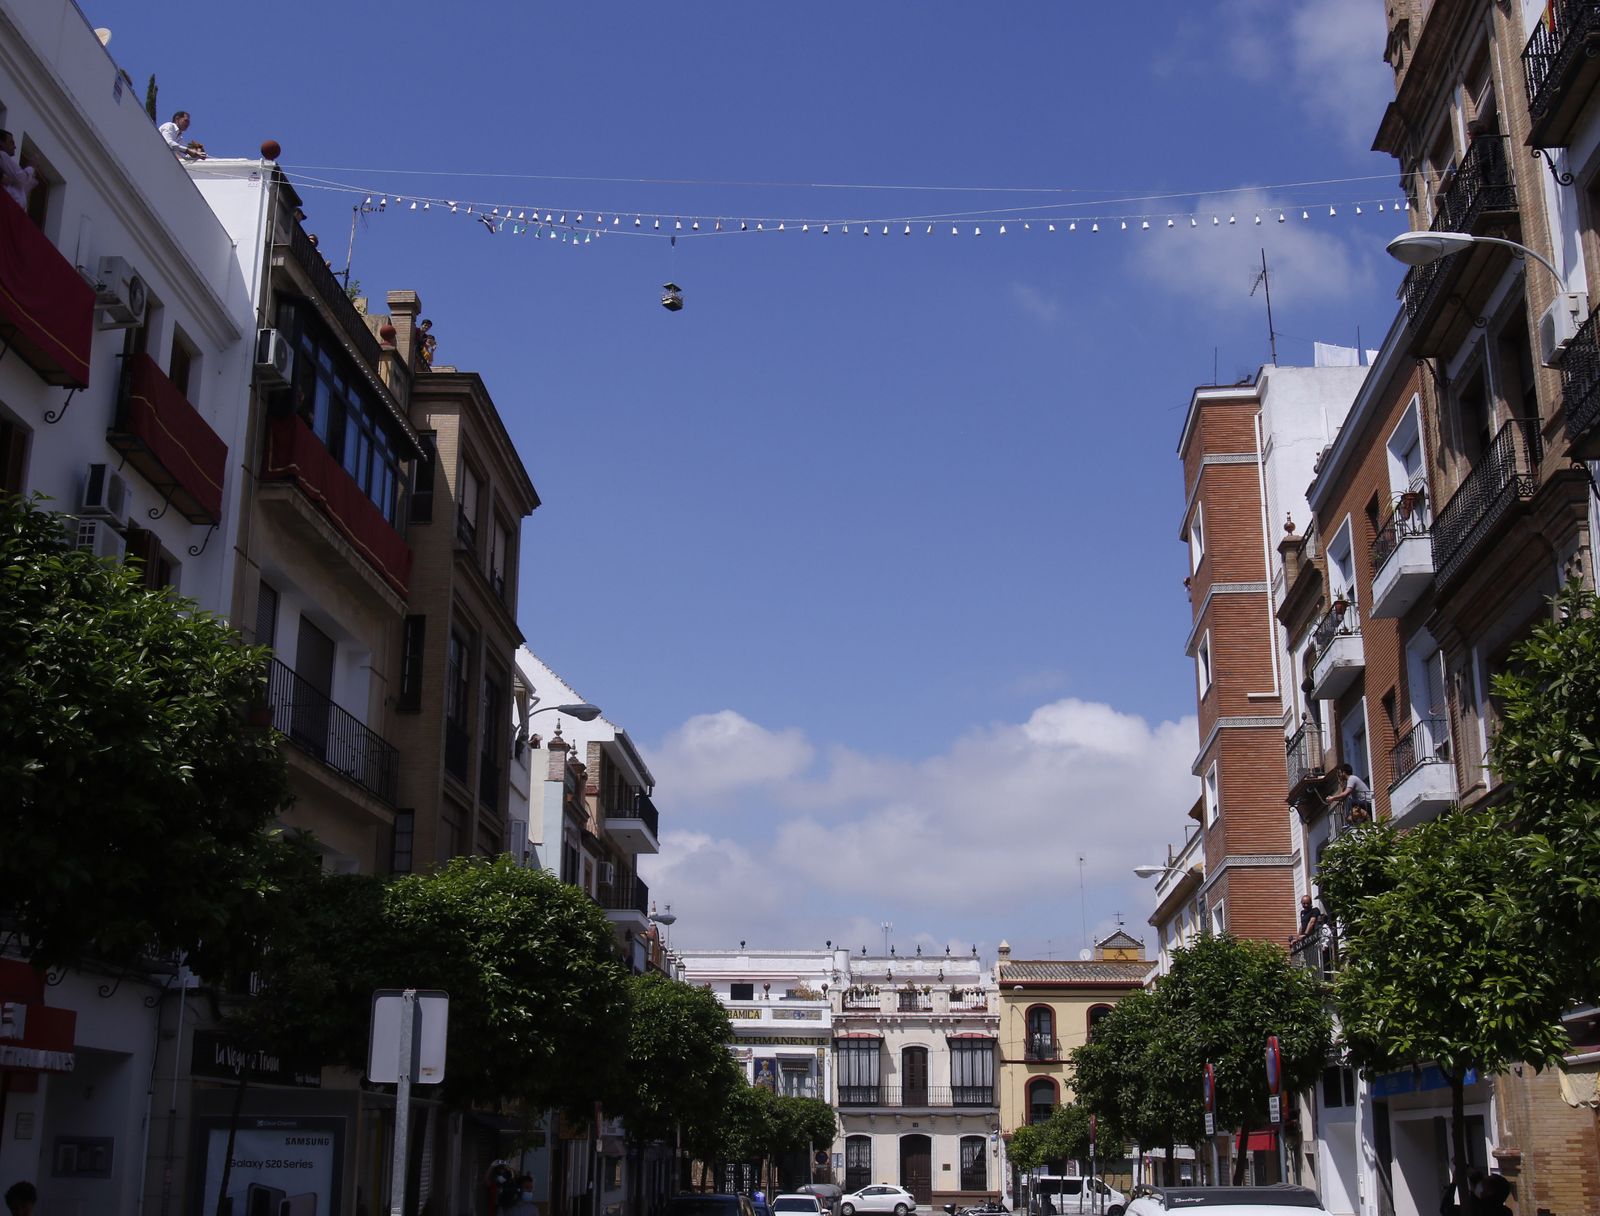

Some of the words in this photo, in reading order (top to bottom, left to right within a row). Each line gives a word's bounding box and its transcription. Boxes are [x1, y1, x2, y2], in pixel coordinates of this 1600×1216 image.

[727, 1009, 760, 1019] RAMICA
[735, 1037, 825, 1045] PERMANENTE
[285, 1137, 330, 1146] SAMSUNG
[230, 1159, 263, 1170] Galaxy
[265, 1159, 282, 1168] S20
[283, 1159, 314, 1168] Series
